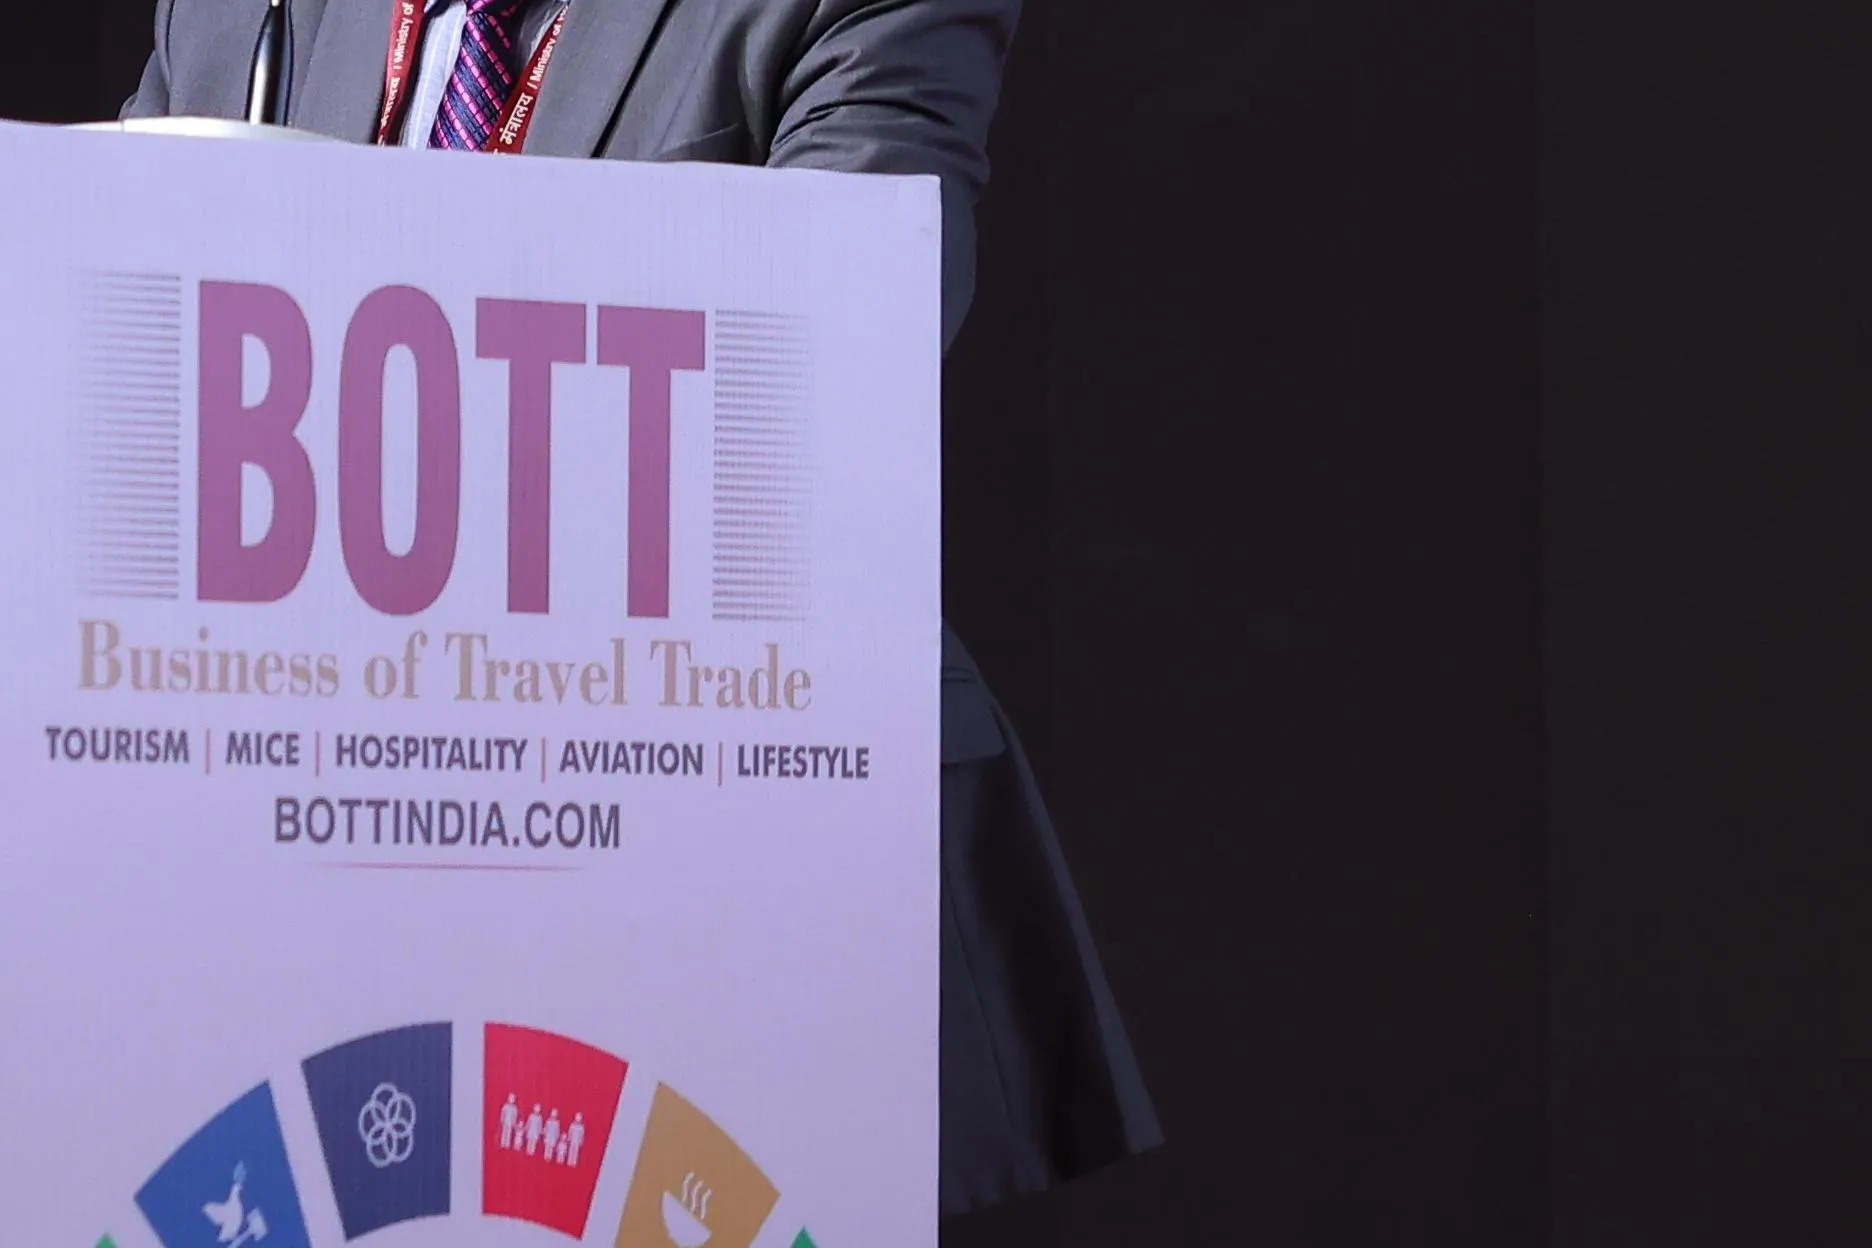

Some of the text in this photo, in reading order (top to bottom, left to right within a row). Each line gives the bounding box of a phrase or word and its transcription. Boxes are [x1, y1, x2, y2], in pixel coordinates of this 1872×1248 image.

[401, 1, 415, 16] of
[393, 17, 414, 64] Ministry
[529, 37, 557, 82] Ministry
[498, 91, 534, 145] मंत्रालय
[195, 278, 707, 621] BOTT
[78, 619, 813, 711] Business of Travel Trade
[45, 726, 871, 780] TOURISM MICE HOSPITALITY AVIATION LIFESTYLE
[274, 796, 621, 849] BOTTINDIA.COM
